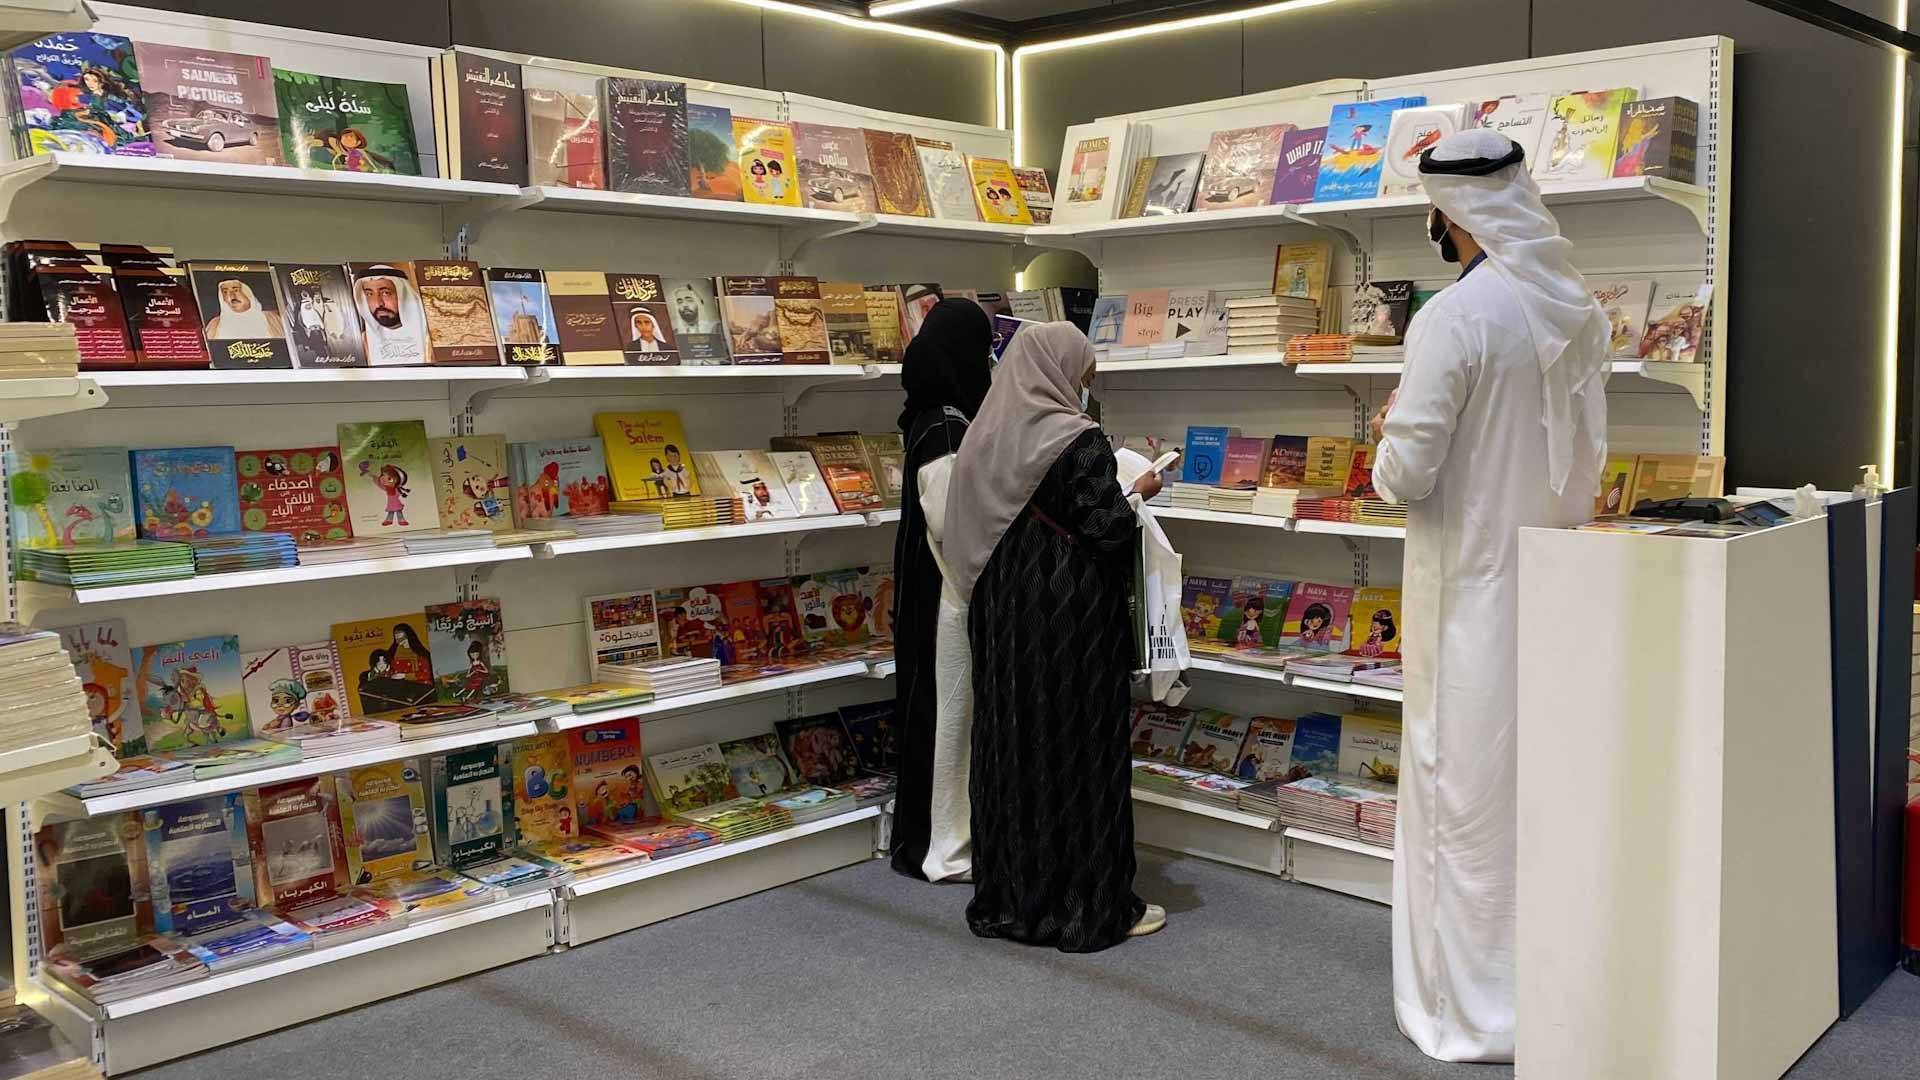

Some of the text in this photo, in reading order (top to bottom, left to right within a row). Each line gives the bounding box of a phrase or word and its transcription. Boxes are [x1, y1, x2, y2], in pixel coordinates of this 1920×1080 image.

[181, 67, 238, 85] SALMEEN
[177, 85, 244, 104] PICTURES
[1285, 141, 1311, 165] WHIP
[70, 295, 98, 305] الأعمال
[148, 297, 174, 307] الأعمال
[1169, 296, 1205, 307] PRESS
[1134, 303, 1153, 318] Big
[1168, 307, 1203, 319] PLAY
[1137, 326, 1160, 339] steps
[625, 428, 665, 445] Salem
[1307, 587, 1327, 597] NAYA
[575, 745, 634, 767] NUMBERS
[279, 880, 328, 900] الكهرباء
[186, 905, 220, 921] الماء
